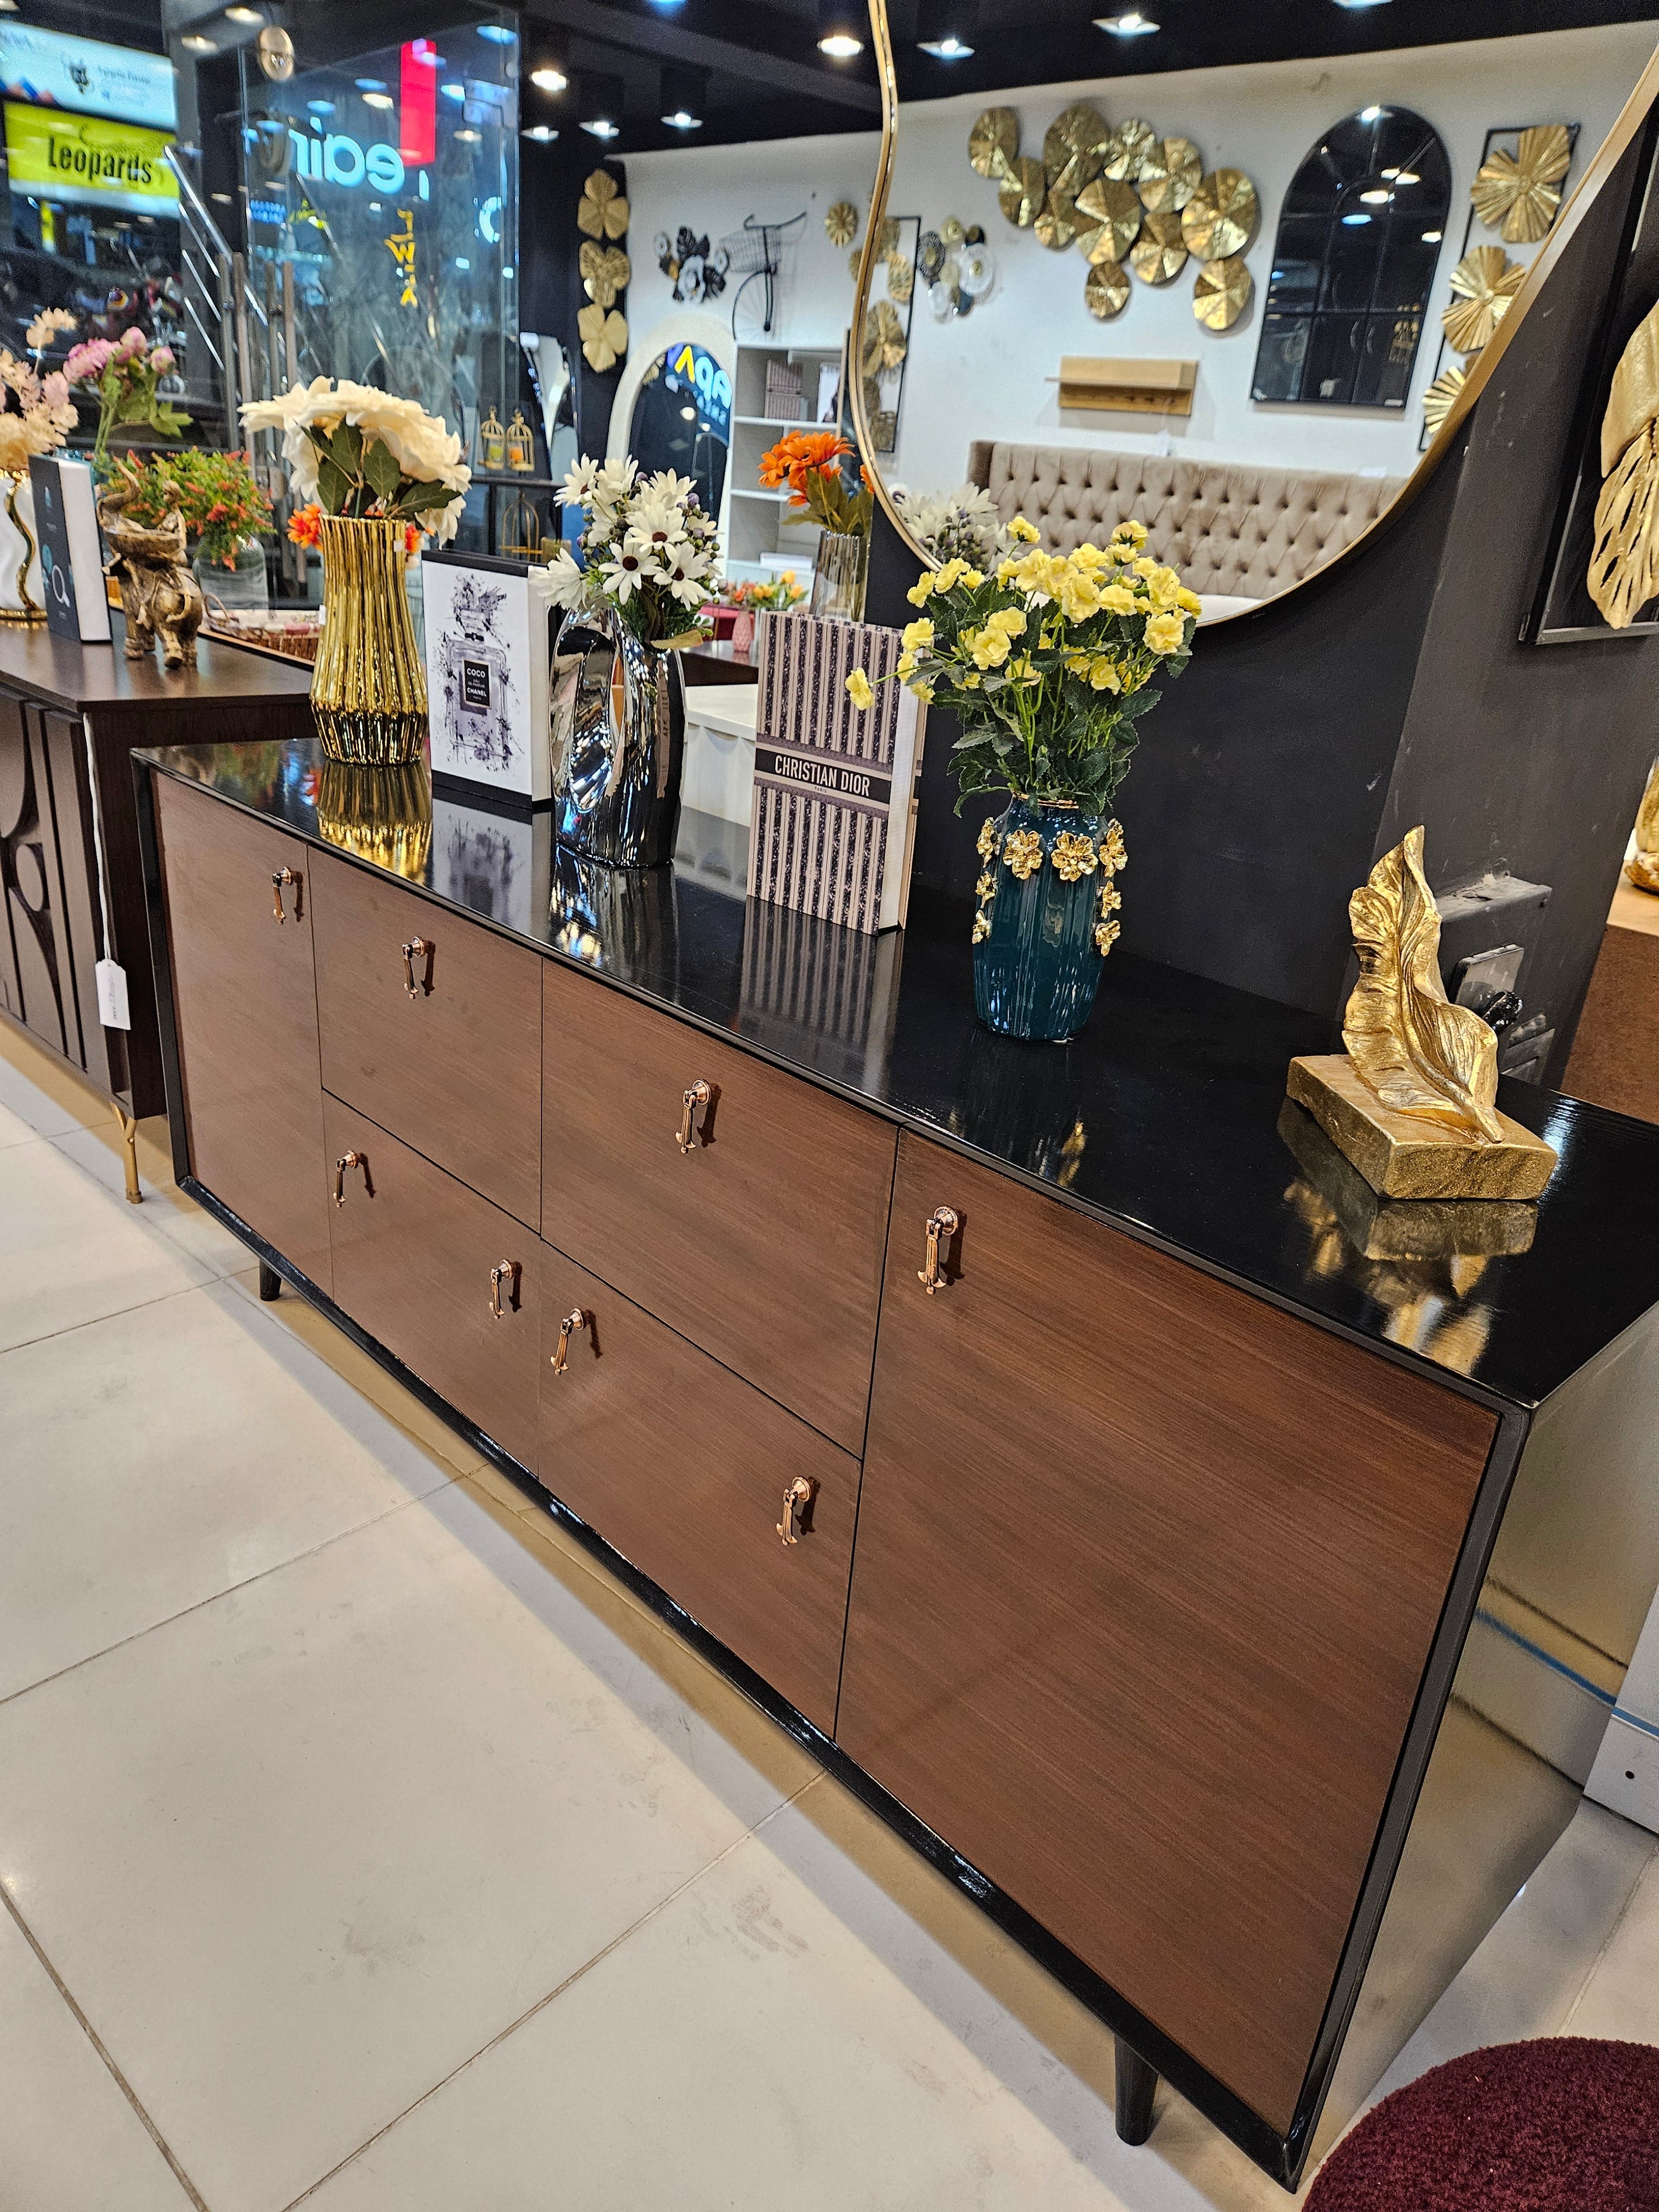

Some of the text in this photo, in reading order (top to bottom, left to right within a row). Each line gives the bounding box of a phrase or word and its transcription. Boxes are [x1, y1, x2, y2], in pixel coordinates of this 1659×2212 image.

[48, 134, 152, 183] Leopards
[467, 667, 486, 678] COCO
[467, 687, 487, 697] CHANEL
[775, 755, 870, 796] CHRISTIAN DIOR
